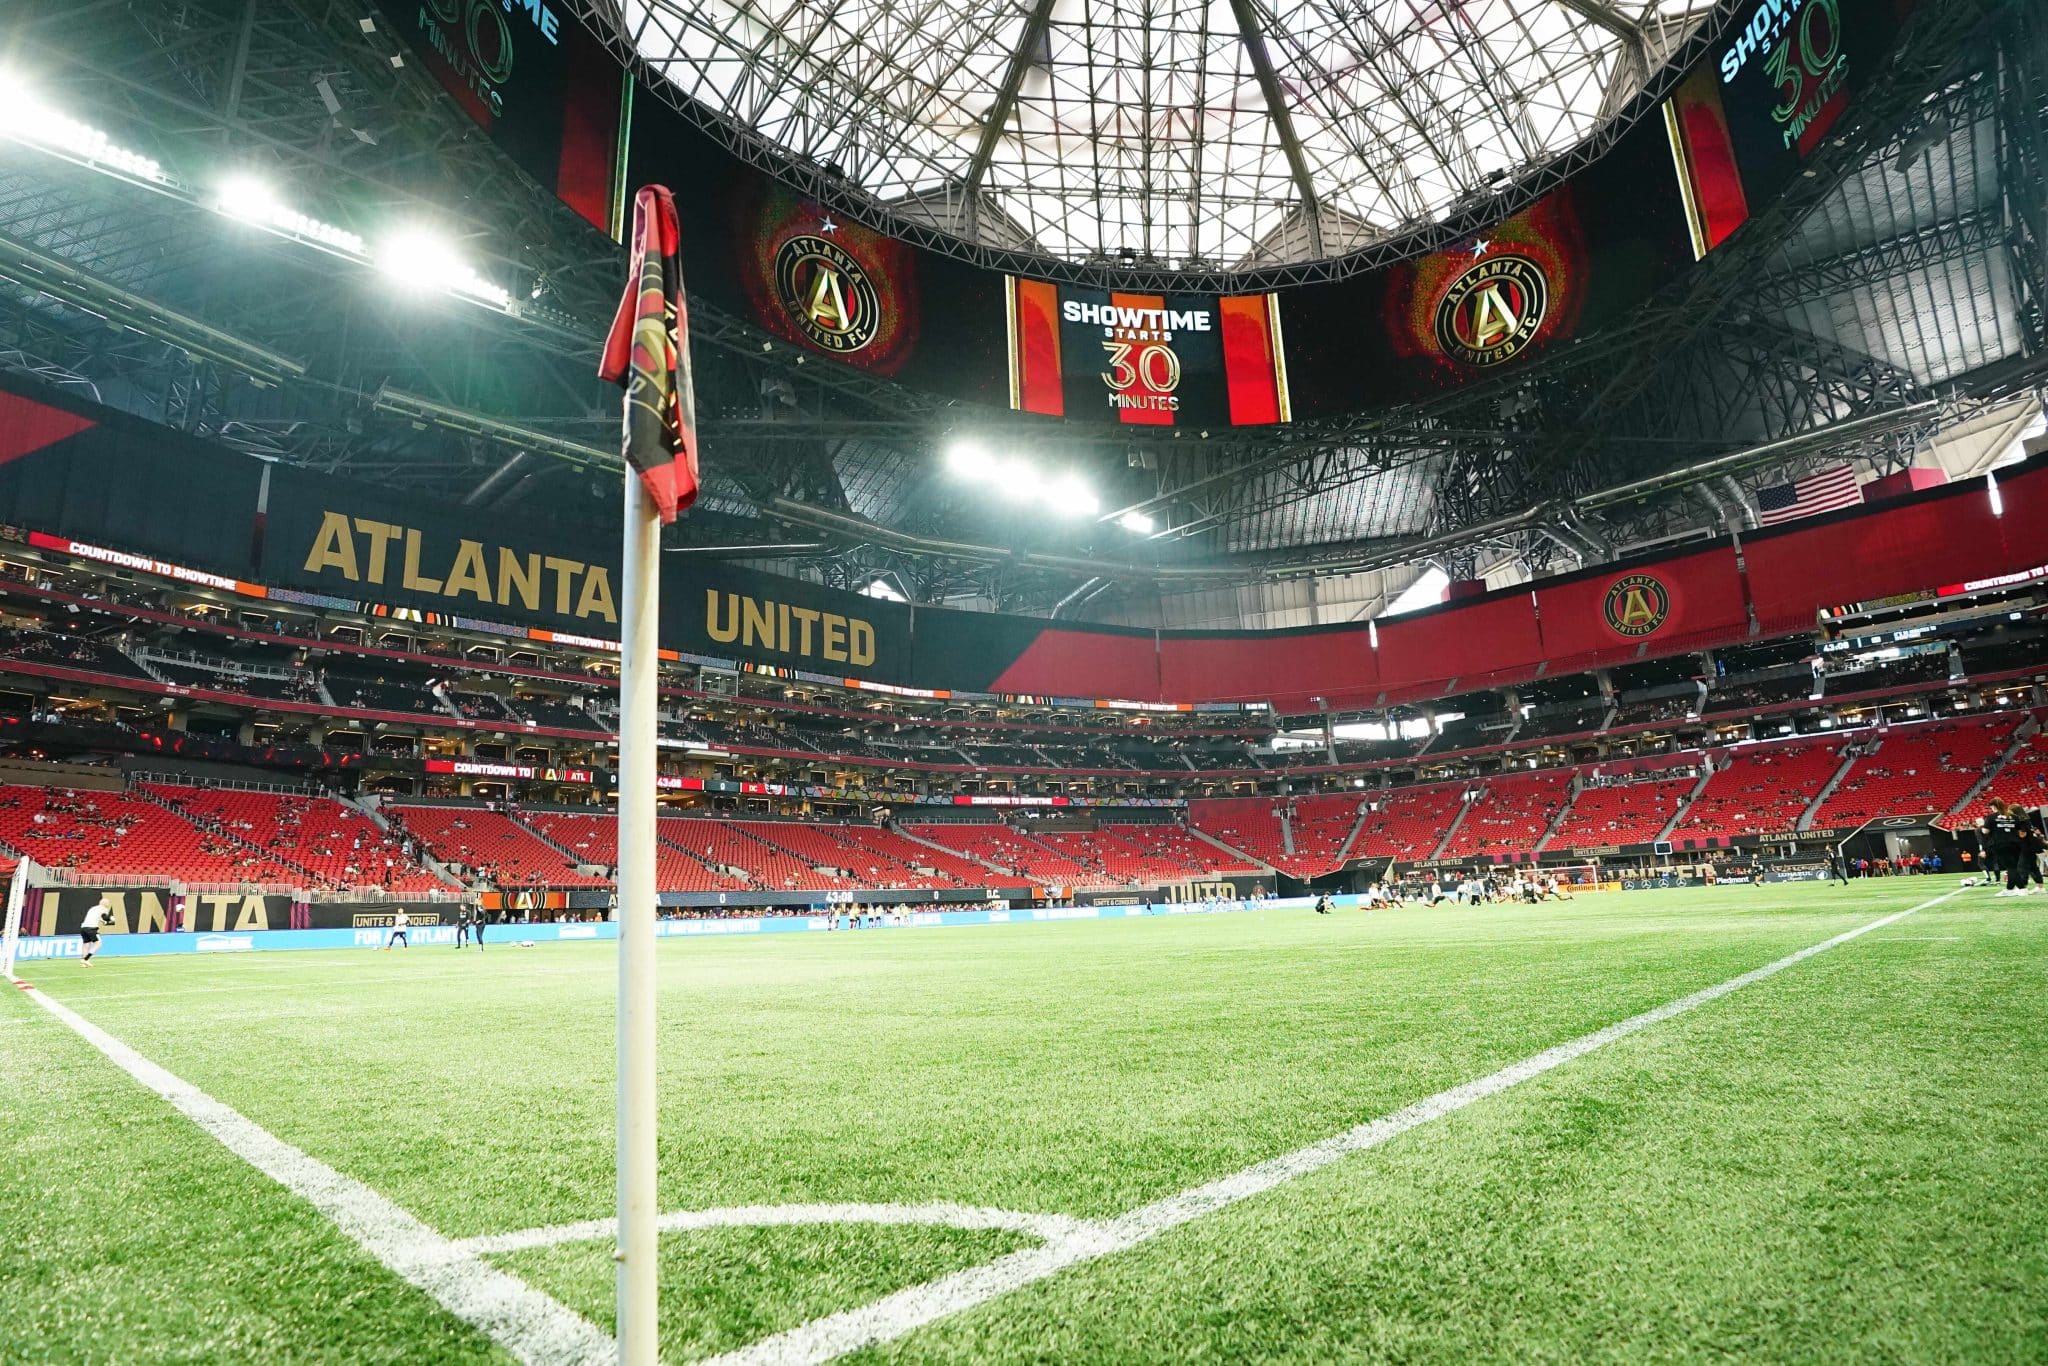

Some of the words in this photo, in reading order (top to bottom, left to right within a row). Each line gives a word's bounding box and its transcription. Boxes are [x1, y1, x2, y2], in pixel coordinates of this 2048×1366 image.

[792, 239, 863, 285] ATLANTA
[1448, 261, 1522, 304] ATLANTA
[787, 300, 843, 348] UNITED
[850, 328, 866, 346] FC
[1063, 300, 1211, 331] SHOWTIME
[1104, 327, 1173, 342] STARTS
[1454, 341, 1515, 364] UNITED
[1518, 316, 1537, 340] FC
[1101, 341, 1181, 393] 30
[1108, 392, 1180, 411] MINUTES
[69, 541, 153, 572] COUNTDOWN
[154, 562, 171, 576] TO
[173, 566, 236, 591] SHOWTIME
[304, 511, 618, 623] ATLANTA
[1612, 577, 1655, 597] ATLANTA
[1964, 571, 2030, 591] COUNTDOWN
[2030, 567, 2045, 578] TO
[707, 589, 875, 667] UNITED
[1614, 621, 1650, 635] UNITED
[1655, 613, 1664, 626] FC
[552, 633, 603, 648] COUNTDOWN
[605, 640, 615, 650] TO
[454, 762, 516, 776] COUNTDOWN
[518, 767, 531, 778] TO
[571, 772, 586, 781] ATL
[749, 784, 758, 792] DC
[1759, 833, 1798, 843] ATLANTA
[1799, 830, 1835, 840] UNITED
[1716, 876, 1749, 884] Piedmont
[825, 891, 853, 903] 43:08
[356, 917, 385, 927] UNITE
[386, 916, 394, 927] &
[354, 930, 382, 945] FOR
[410, 926, 459, 943] ATLANT
[18, 938, 84, 957] UNITE
